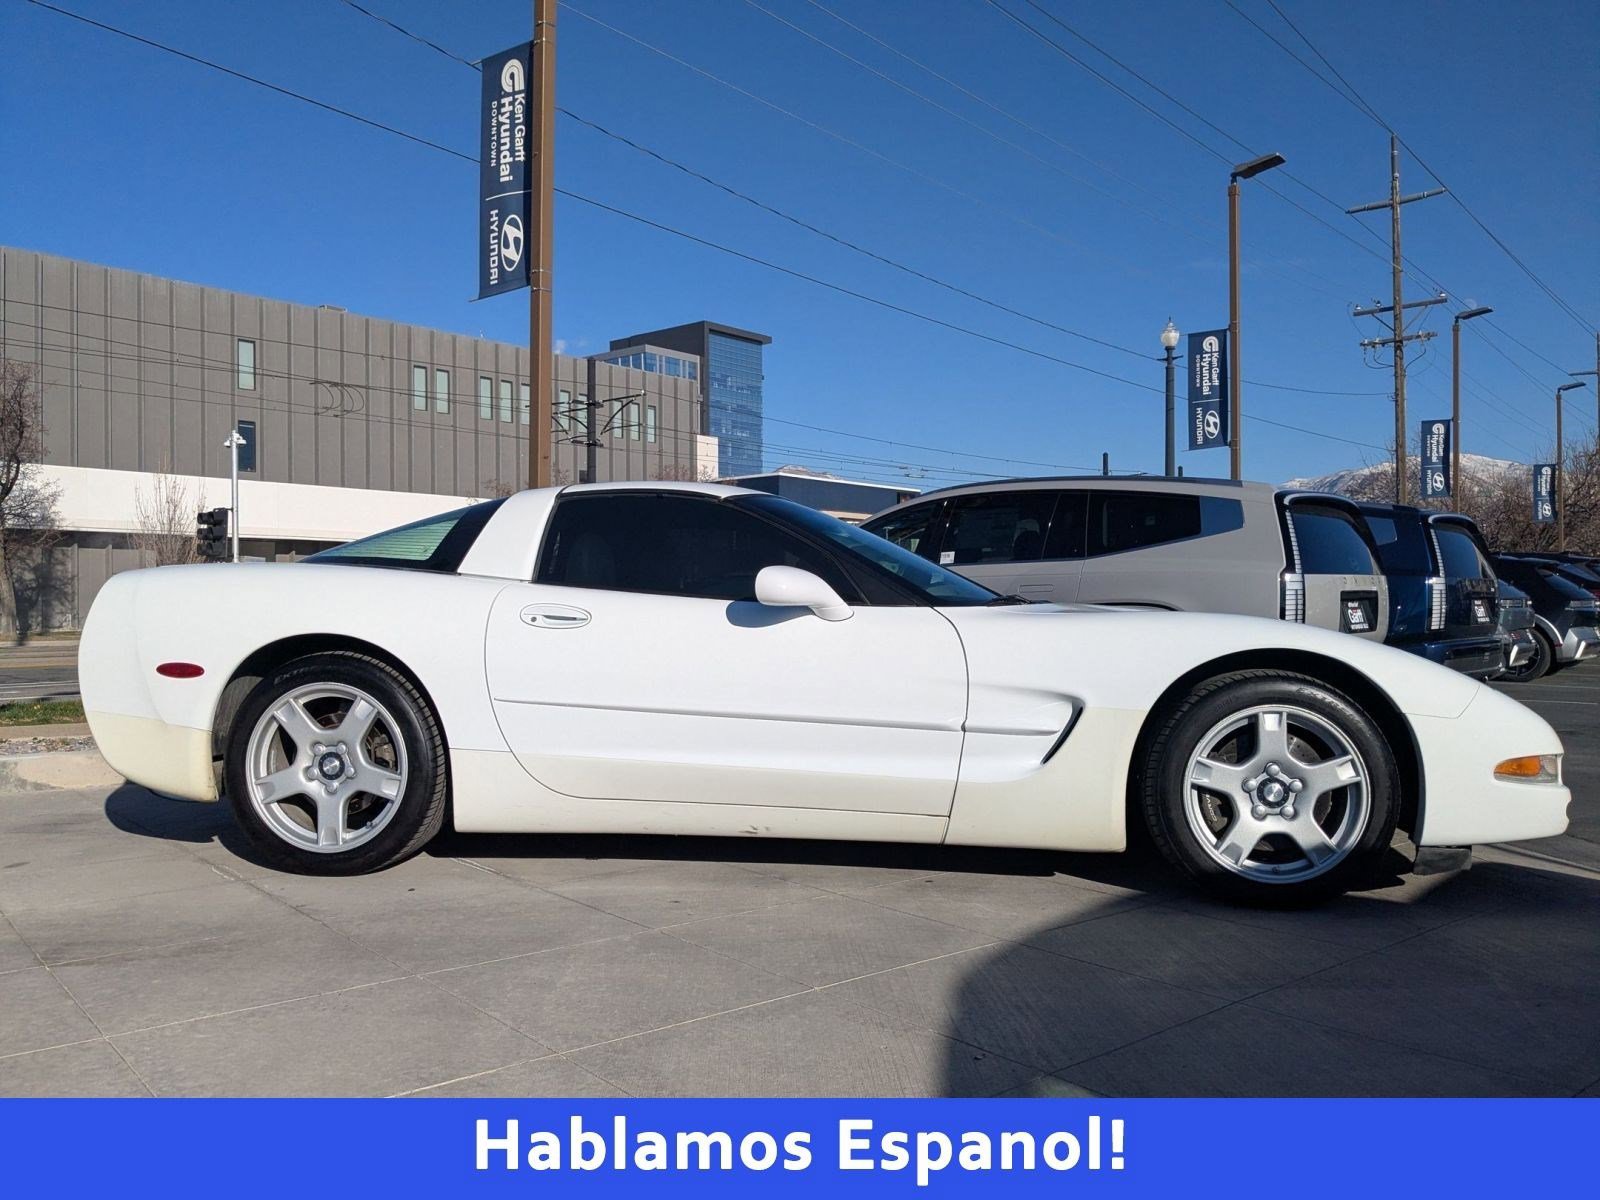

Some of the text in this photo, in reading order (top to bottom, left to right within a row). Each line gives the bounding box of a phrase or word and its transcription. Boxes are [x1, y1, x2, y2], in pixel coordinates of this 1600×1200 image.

[498, 96, 513, 182] Hyundai
[514, 92, 526, 162] Ken Garff
[490, 209, 499, 285] HYUNDAI
[1201, 353, 1212, 395] Hyundai
[1211, 352, 1219, 367] Ken
